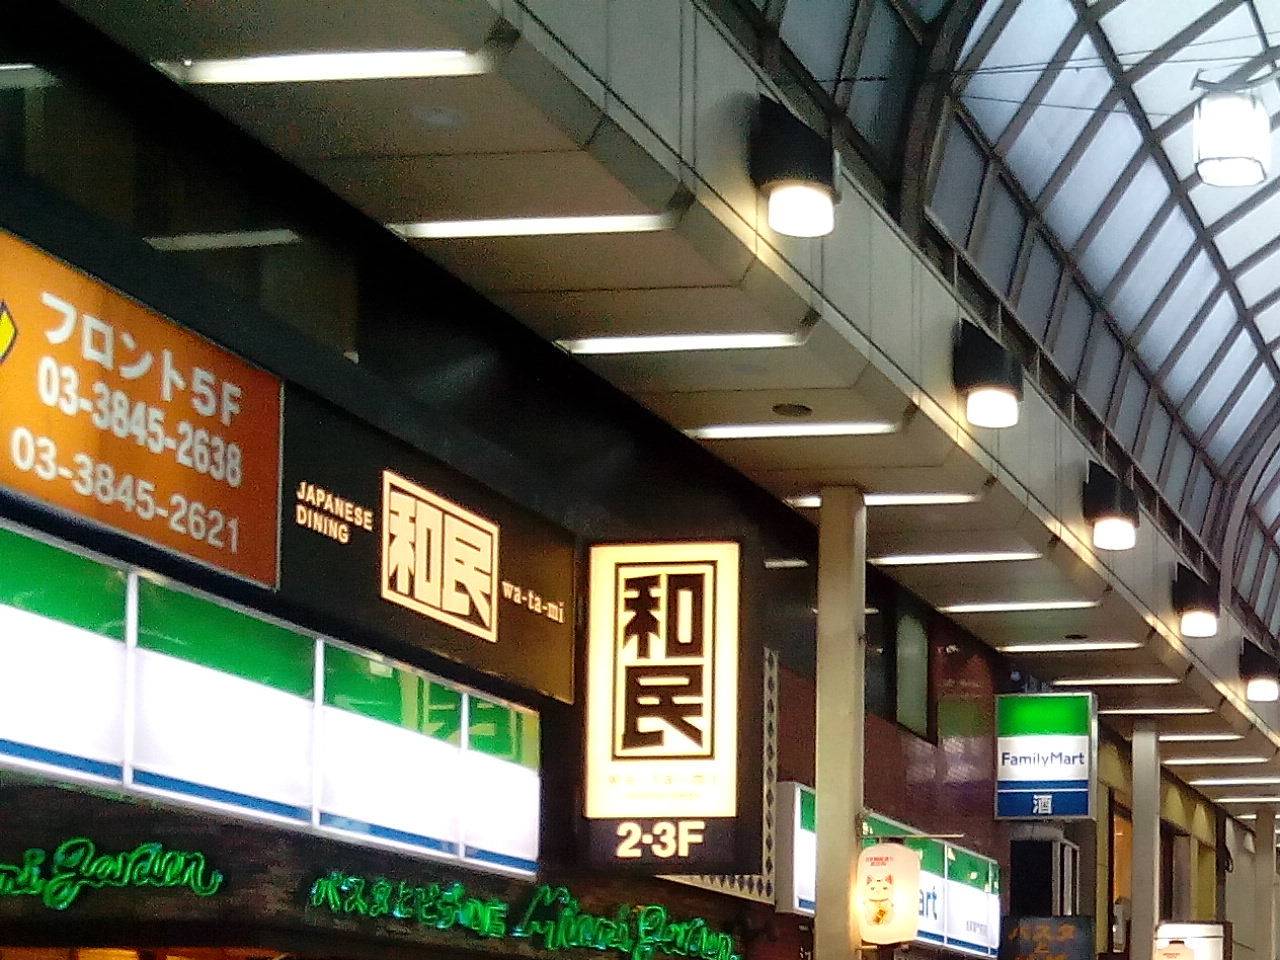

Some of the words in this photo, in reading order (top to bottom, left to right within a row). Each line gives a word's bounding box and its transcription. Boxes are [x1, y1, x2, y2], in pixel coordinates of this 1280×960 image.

[37, 356, 243, 488] 03-3845-2638
[41, 291, 243, 427] フロント5F
[10, 427, 239, 555] 03-3845-2621
[296, 481, 374, 532] JAPANESE
[296, 505, 350, 544] DINING
[386, 488, 494, 630] 和民
[501, 580, 565, 624] wa-ta-mi
[622, 573, 705, 750] 和民
[1001, 752, 1085, 768] FamilyMart
